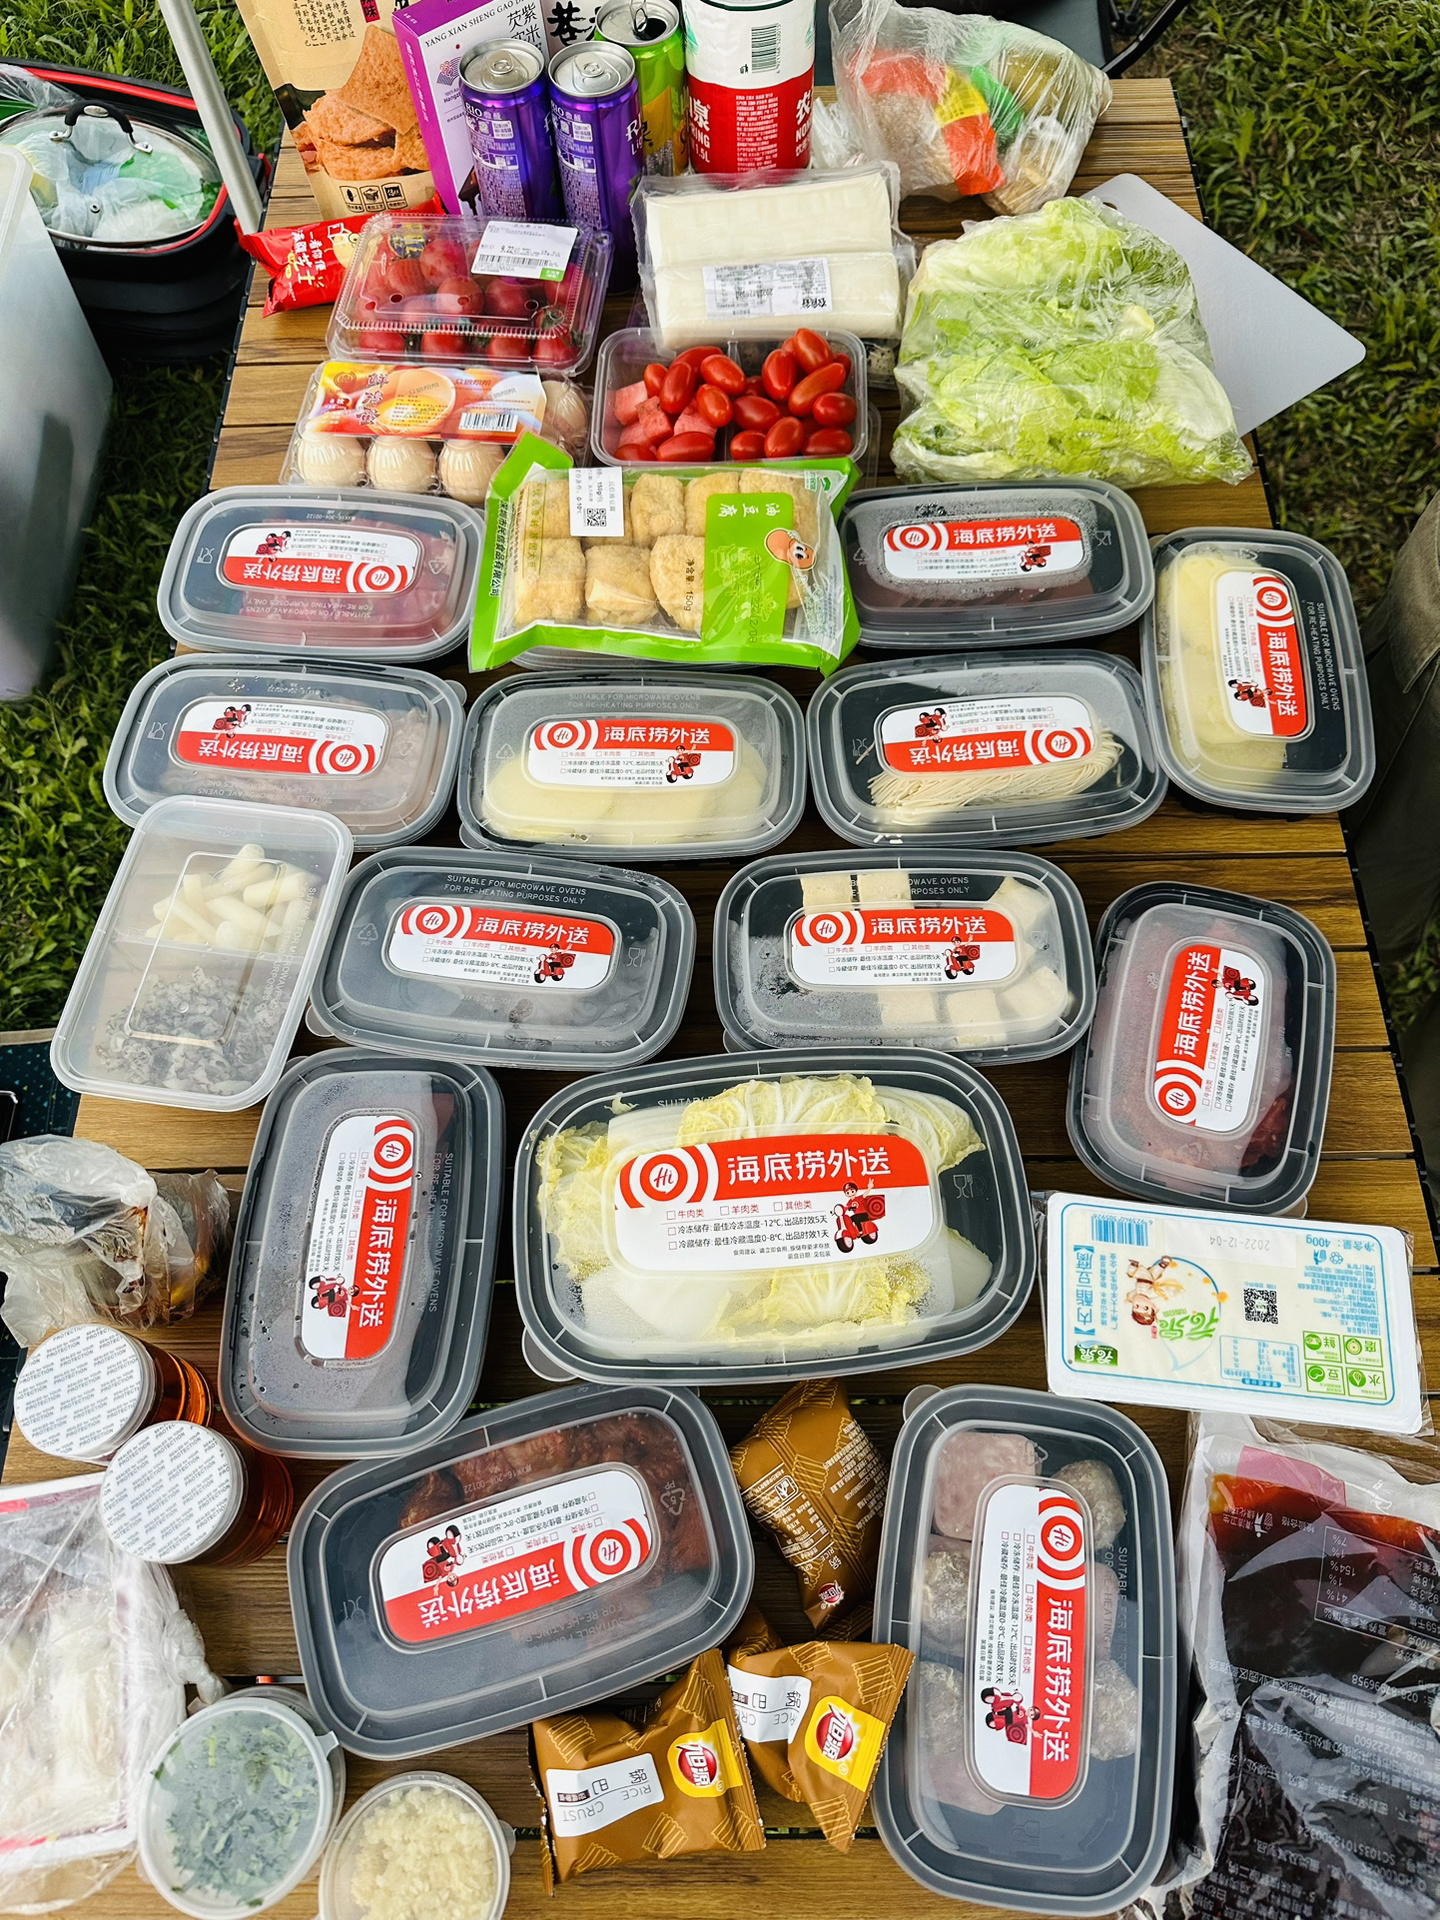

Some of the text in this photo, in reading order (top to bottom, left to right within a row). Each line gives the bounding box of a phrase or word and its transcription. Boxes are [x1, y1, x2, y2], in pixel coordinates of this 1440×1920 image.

[424, 1, 514, 48] YANG XIAN SHENG GAO
[547, 0, 602, 47] 巷
[466, 102, 483, 117] RIO
[717, 502, 782, 518] 油豆腐
[953, 523, 1058, 546] 海底捞外送
[489, 500, 509, 598] 深圳市民信食品有限公司
[241, 562, 343, 583] 海底捞外送
[1307, 601, 1315, 617] FOR
[1317, 603, 1328, 632] SUITABLE
[1322, 633, 1330, 647] FOR
[1267, 631, 1294, 716] 海底捞外送
[1315, 656, 1326, 691] PURPOSES
[1320, 692, 1330, 710] ONLY
[1330, 688, 1340, 711] OVENS
[604, 727, 711, 744] 海底捞外送
[196, 738, 305, 762] 海底捞外送
[909, 739, 1019, 763] 海底捞外送
[444, 884, 585, 905] FOR RE-HEATING PURPOSES ONLY
[447, 874, 587, 896] SUITABLE FOR MICROWAVE OVENS
[474, 917, 591, 945] 海底捞外送
[872, 917, 987, 935] 海底捞外送
[1174, 949, 1212, 1058] 海底捞外送
[432, 1153, 442, 1171] FOR
[728, 1147, 891, 1186] 海底捞外送
[441, 1153, 453, 1196] SUITABLE
[439, 1198, 449, 1217] FOR
[678, 1200, 812, 1219] 牛肉类 羊肉类 其他类
[1208, 1234, 1271, 1252] 2022-12-04
[1305, 1234, 1331, 1248] 400g
[358, 1198, 397, 1329] 海底捞外送
[429, 1279, 440, 1312] OVENS
[47, 1341, 80, 1359] PROTECTION
[1322, 1336, 1336, 1349] 鲜
[54, 1367, 87, 1385] PROTECTION
[1326, 1368, 1340, 1381] 豆
[1367, 1373, 1381, 1386] 水
[119, 1441, 151, 1467] PROTECTION
[1333, 1534, 1347, 1546] 7%
[1104, 1545, 1114, 1568] FOR
[1118, 1547, 1128, 1601] SUITABLE
[1330, 1560, 1356, 1577] 154%
[1329, 1574, 1343, 1586] 1%
[418, 1558, 559, 1627] 海底捞外送
[1326, 1588, 1348, 1603] 41%
[602, 1602, 623, 1615] FOR
[1042, 1597, 1072, 1764] 海底捞外送
[821, 1702, 852, 1762] 旭源
[676, 1742, 719, 1788] 旭源
[562, 1784, 652, 1823] RICE CRUST
